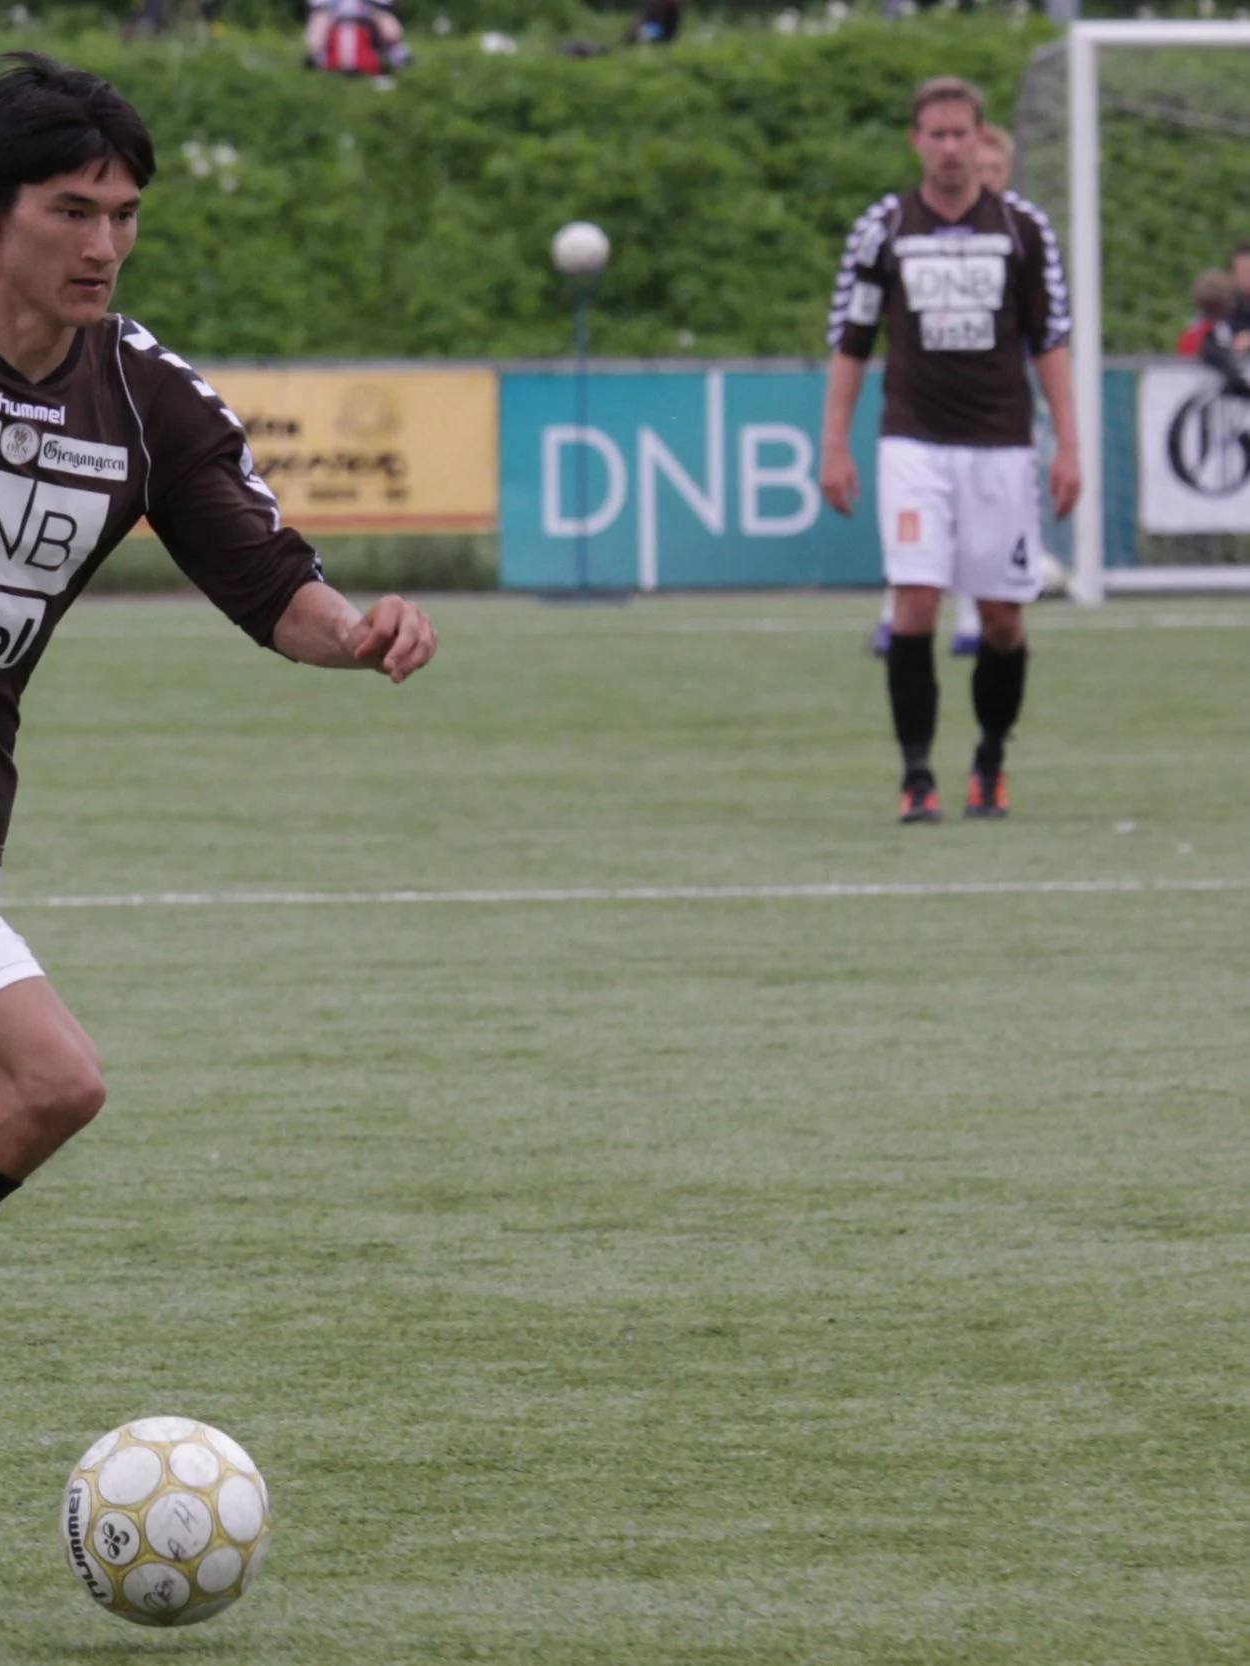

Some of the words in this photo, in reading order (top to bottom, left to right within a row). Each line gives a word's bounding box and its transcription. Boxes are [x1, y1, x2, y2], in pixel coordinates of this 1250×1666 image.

[42, 439, 126, 472] Gjengangeren
[542, 368, 821, 591] DNB
[1010, 532, 1029, 574] 4
[67, 1487, 108, 1600] hummel
